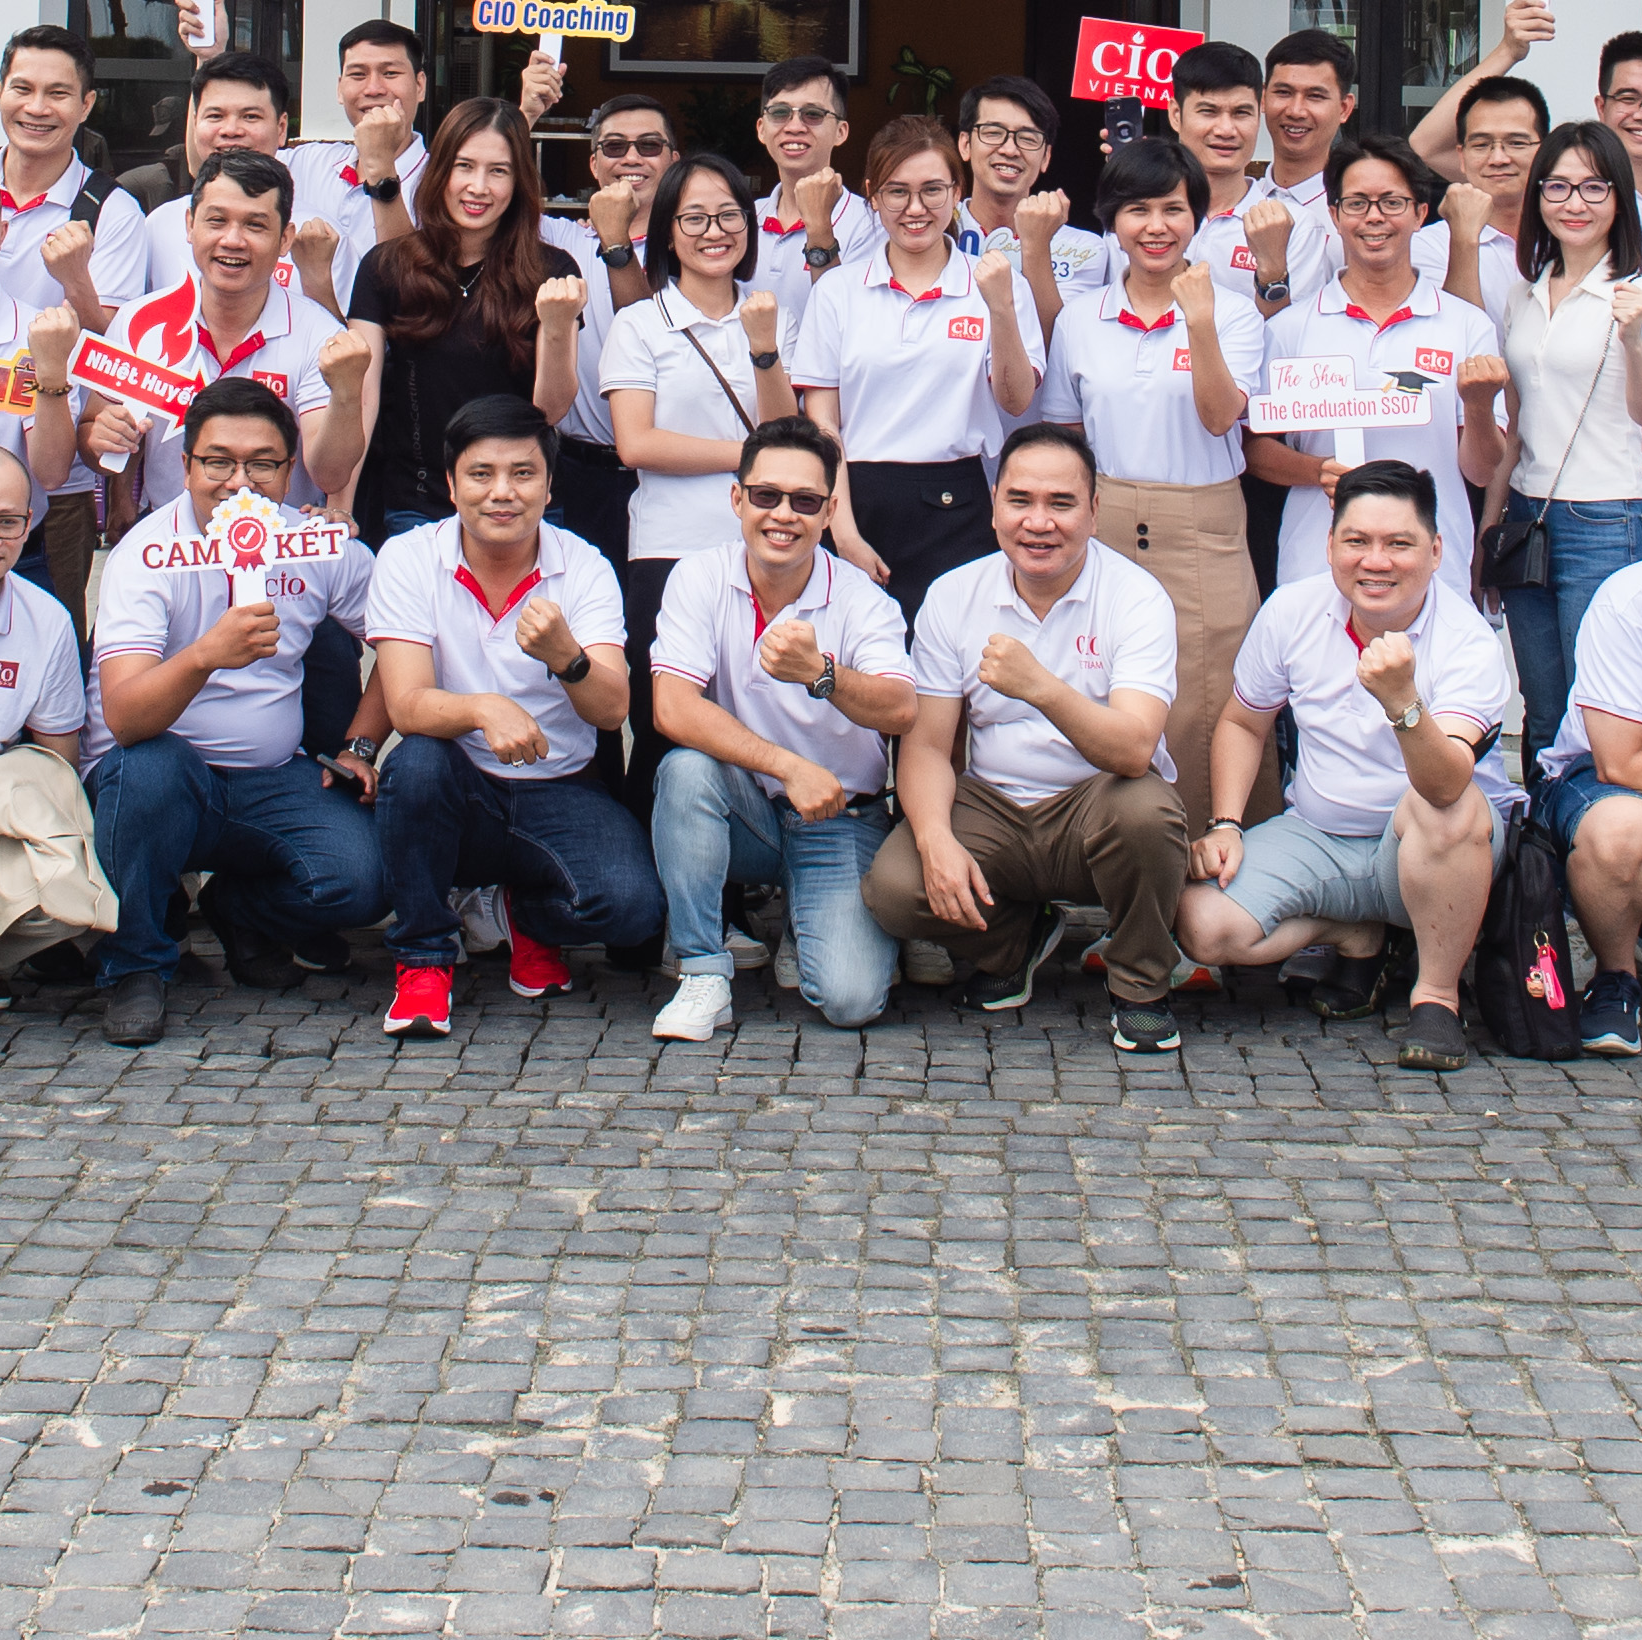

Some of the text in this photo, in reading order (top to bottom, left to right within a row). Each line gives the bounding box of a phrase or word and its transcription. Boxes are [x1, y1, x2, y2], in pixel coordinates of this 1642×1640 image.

[478, 0, 629, 36] CIO Coaching
[1089, 80, 1171, 102] VIETNA
[85, 348, 140, 387] Nhiệt
[1272, 362, 1352, 391] The Show
[1259, 394, 1419, 421] The Graduation SS07
[142, 522, 344, 570] CAM KẾT
